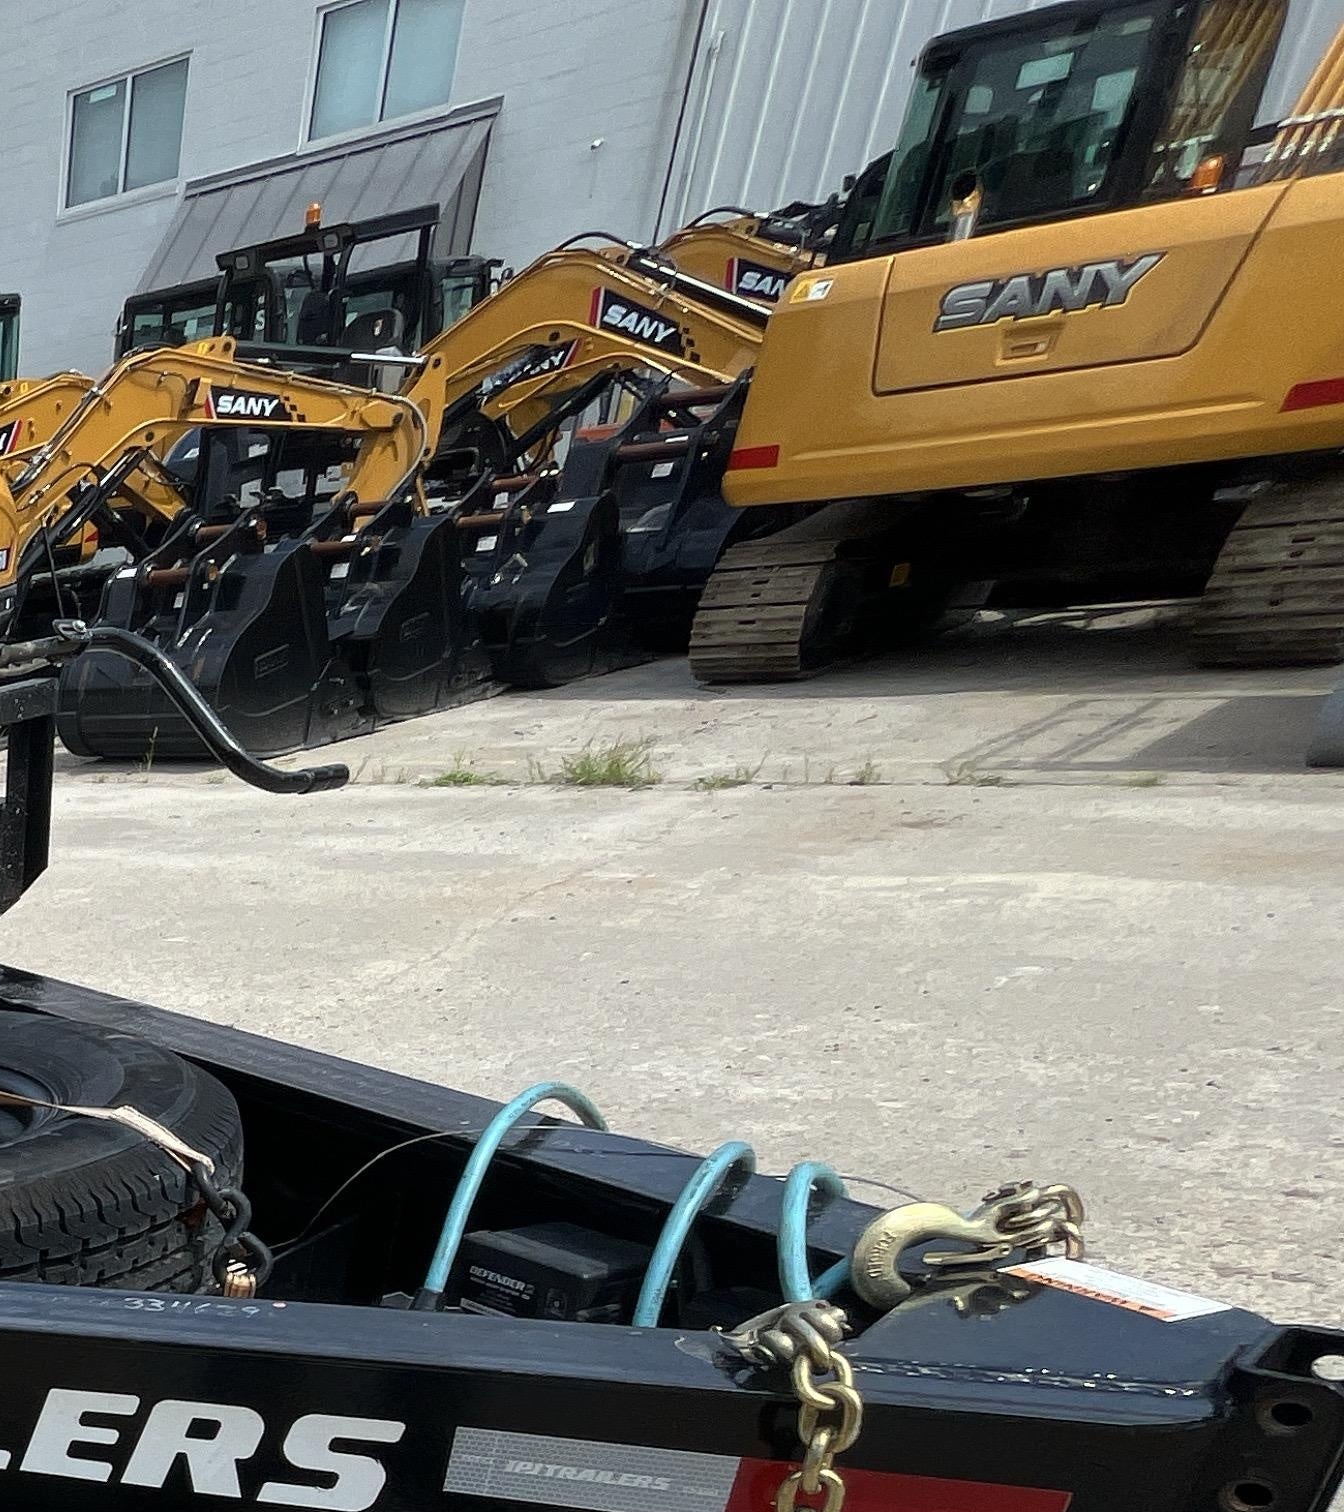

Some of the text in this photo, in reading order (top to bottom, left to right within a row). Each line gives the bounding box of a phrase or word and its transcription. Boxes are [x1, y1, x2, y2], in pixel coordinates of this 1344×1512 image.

[738, 271, 786, 297] SAN
[934, 252, 1166, 332] SANY
[602, 303, 678, 343] SANY
[216, 394, 281, 418] SANY
[469, 1265, 526, 1291] DEFENDER
